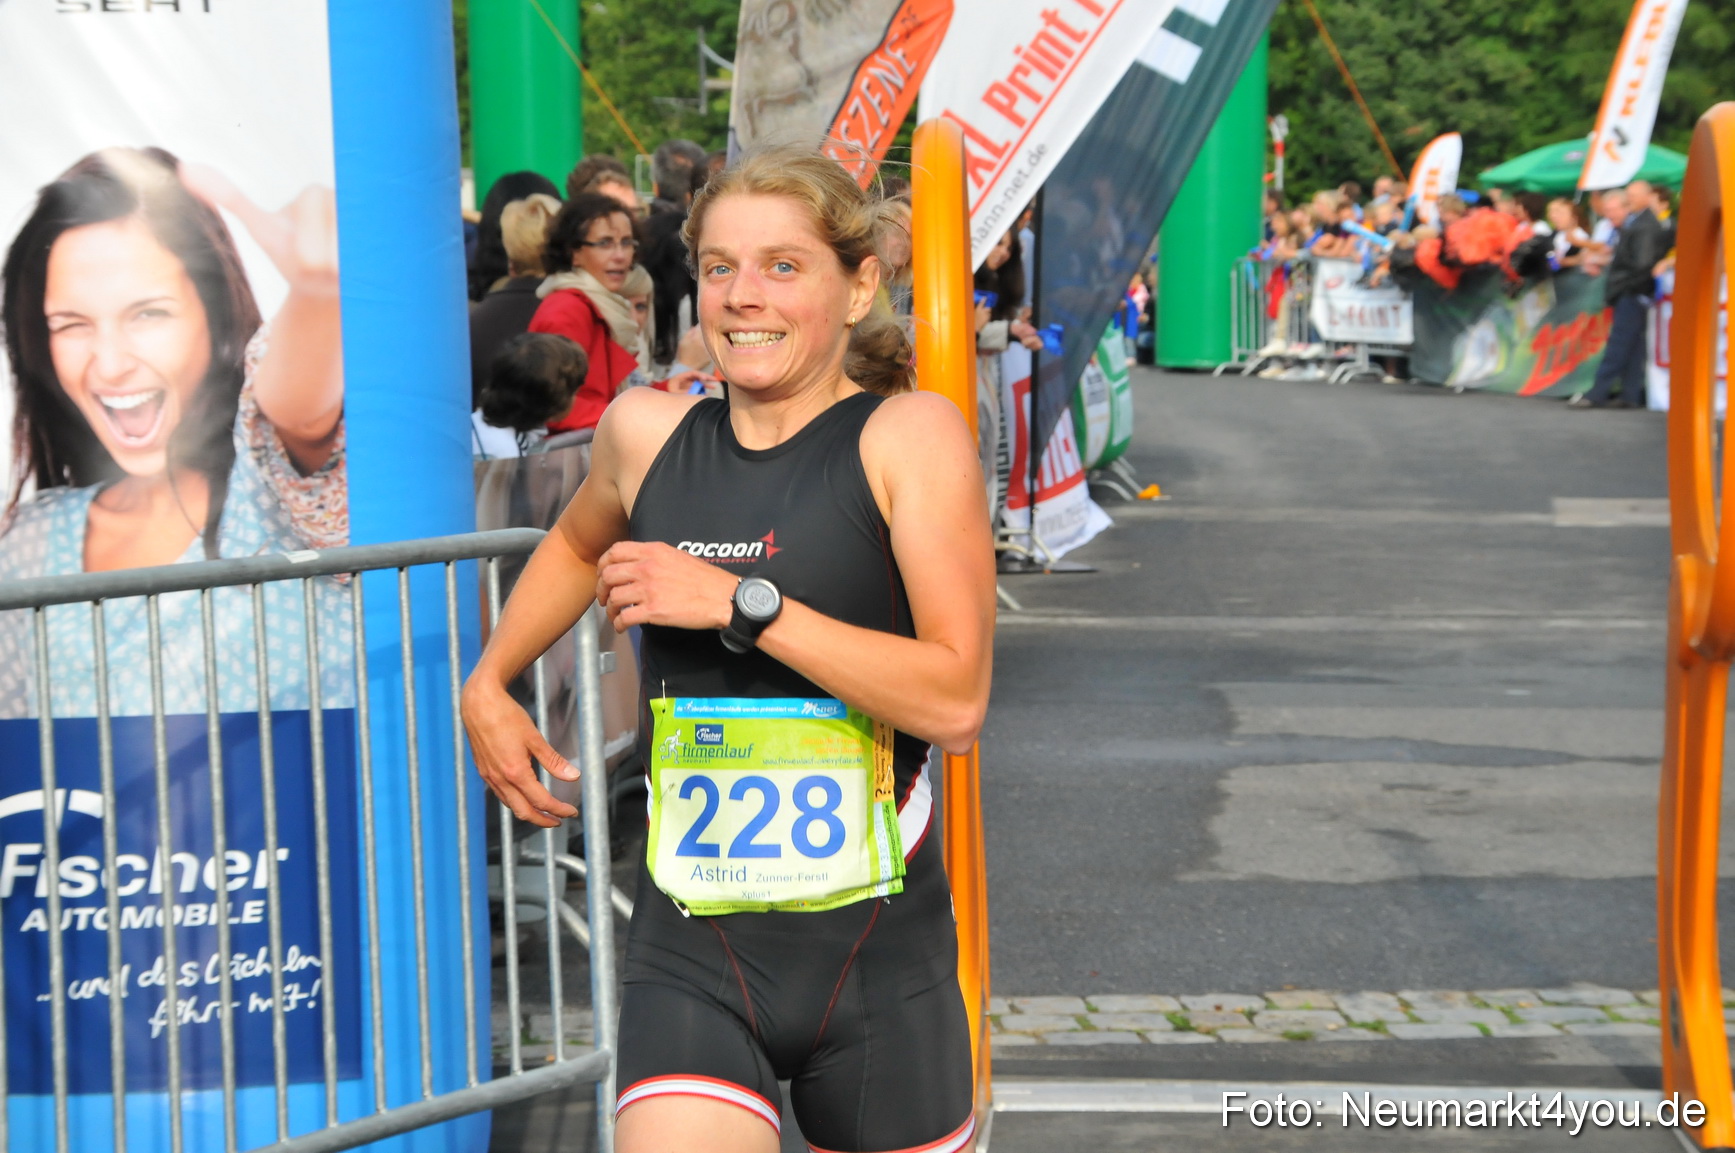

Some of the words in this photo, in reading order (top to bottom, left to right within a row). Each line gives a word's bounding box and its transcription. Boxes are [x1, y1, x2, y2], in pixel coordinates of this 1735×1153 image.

[981, 8, 1089, 129] Print
[677, 541, 763, 558] cocoon
[683, 743, 754, 758] firmenlauf
[675, 774, 846, 859] 228
[690, 864, 747, 883] Astrid
[20, 900, 266, 932] AUTOMOBILE
